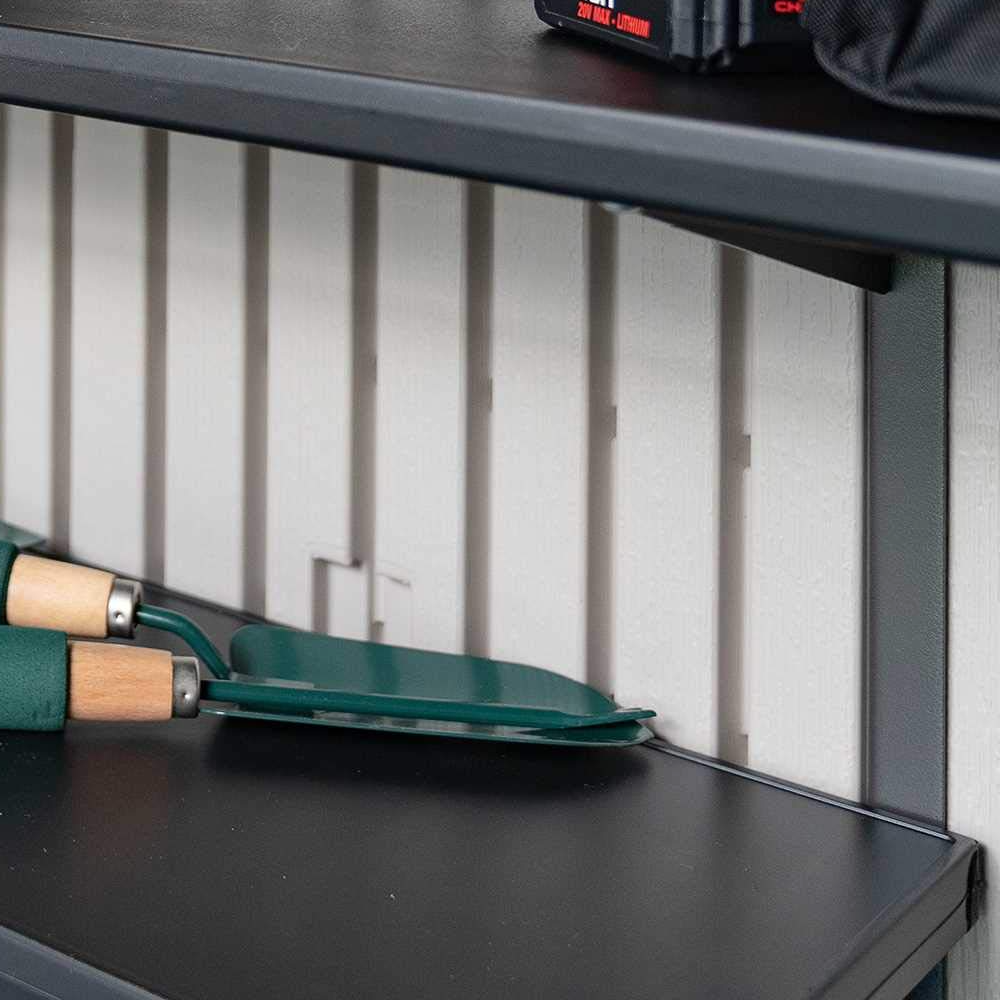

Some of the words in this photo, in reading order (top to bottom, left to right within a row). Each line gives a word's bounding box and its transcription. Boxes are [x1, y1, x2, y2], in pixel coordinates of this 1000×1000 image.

[577, 1, 593, 20] 20V
[593, 5, 612, 26] MAX
[616, 12, 652, 38] LITHIUM
